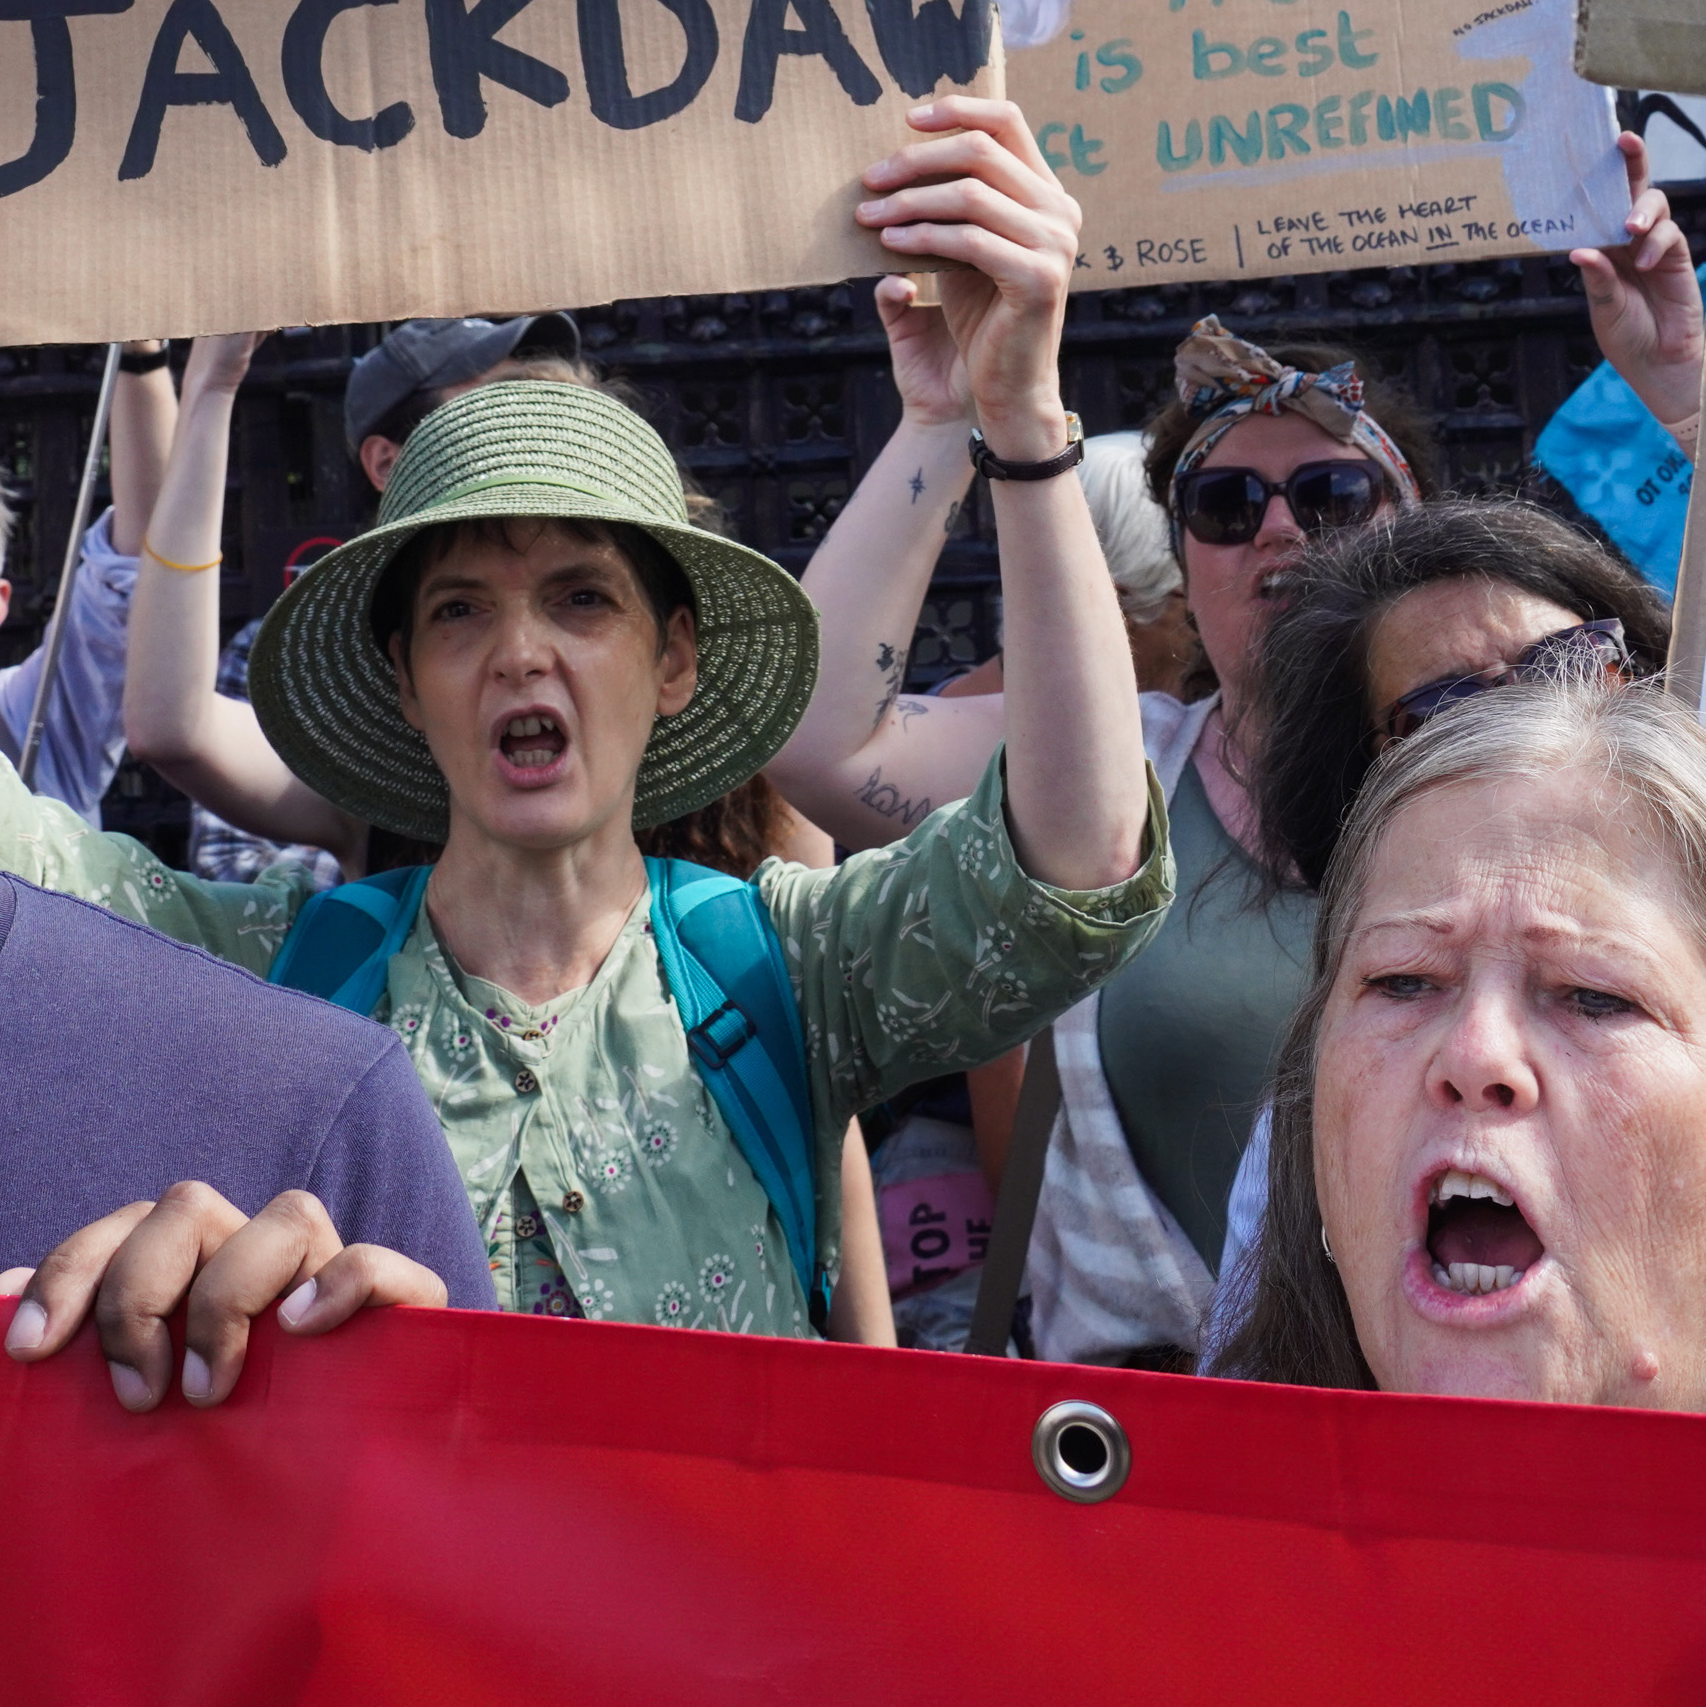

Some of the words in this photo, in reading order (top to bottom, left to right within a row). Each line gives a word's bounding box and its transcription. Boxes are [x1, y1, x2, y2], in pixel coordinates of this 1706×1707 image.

[1070, 30, 1144, 94] is
[1193, 10, 1379, 81] best
[1156, 83, 1527, 173] UNREFINED
[1257, 212, 1329, 236] LEAVE
[1339, 207, 1387, 227] THE
[1398, 195, 1478, 219] HEART
[1267, 236, 1293, 259] OF
[1299, 234, 1344, 256] THE
[1352, 226, 1419, 252] OCEAN
[1428, 223, 1453, 244] IN
[1506, 213, 1575, 238] OCEAN
[1136, 238, 1208, 267] ROSE
